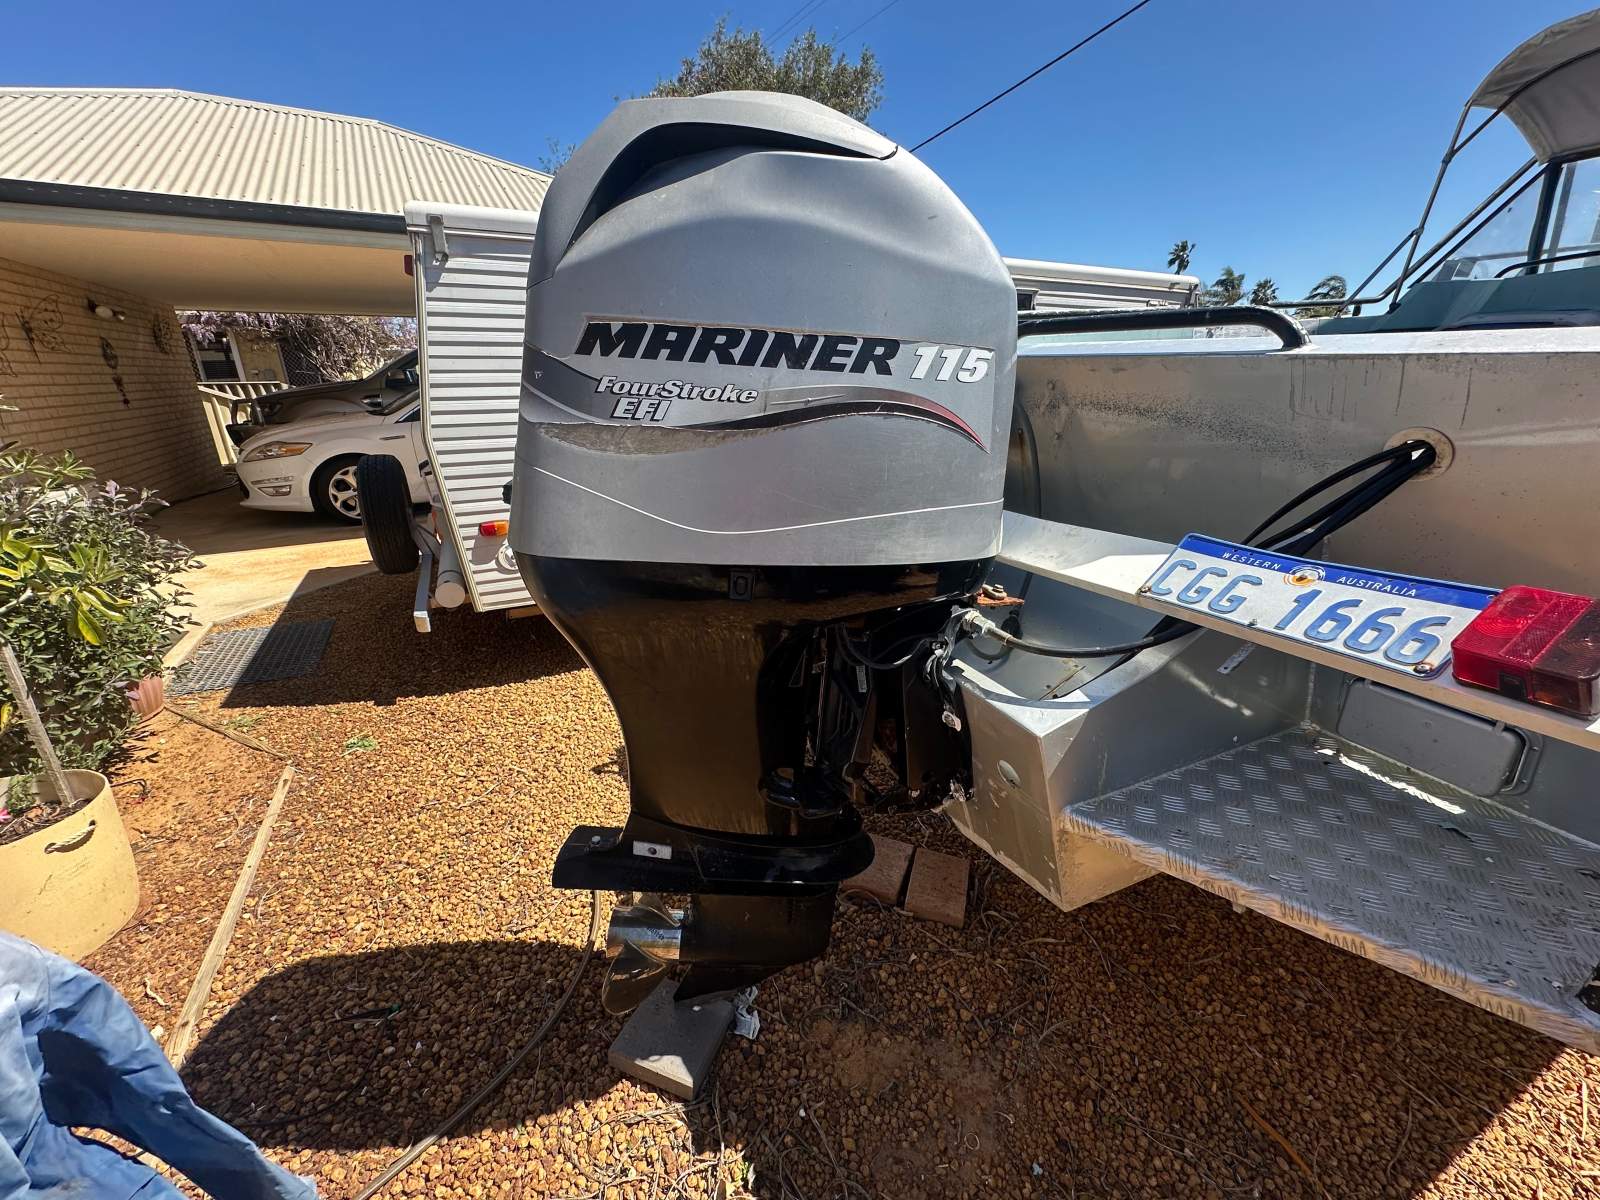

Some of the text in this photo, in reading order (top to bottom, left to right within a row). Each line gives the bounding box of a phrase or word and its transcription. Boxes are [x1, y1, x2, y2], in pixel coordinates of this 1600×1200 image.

[575, 322, 992, 384] MARINER 115
[595, 376, 758, 404] FourStroke
[611, 398, 671, 421] EFI
[1223, 553, 1417, 597] WESTERN AUSTRALIA
[1150, 560, 1452, 664] CGG 1666
